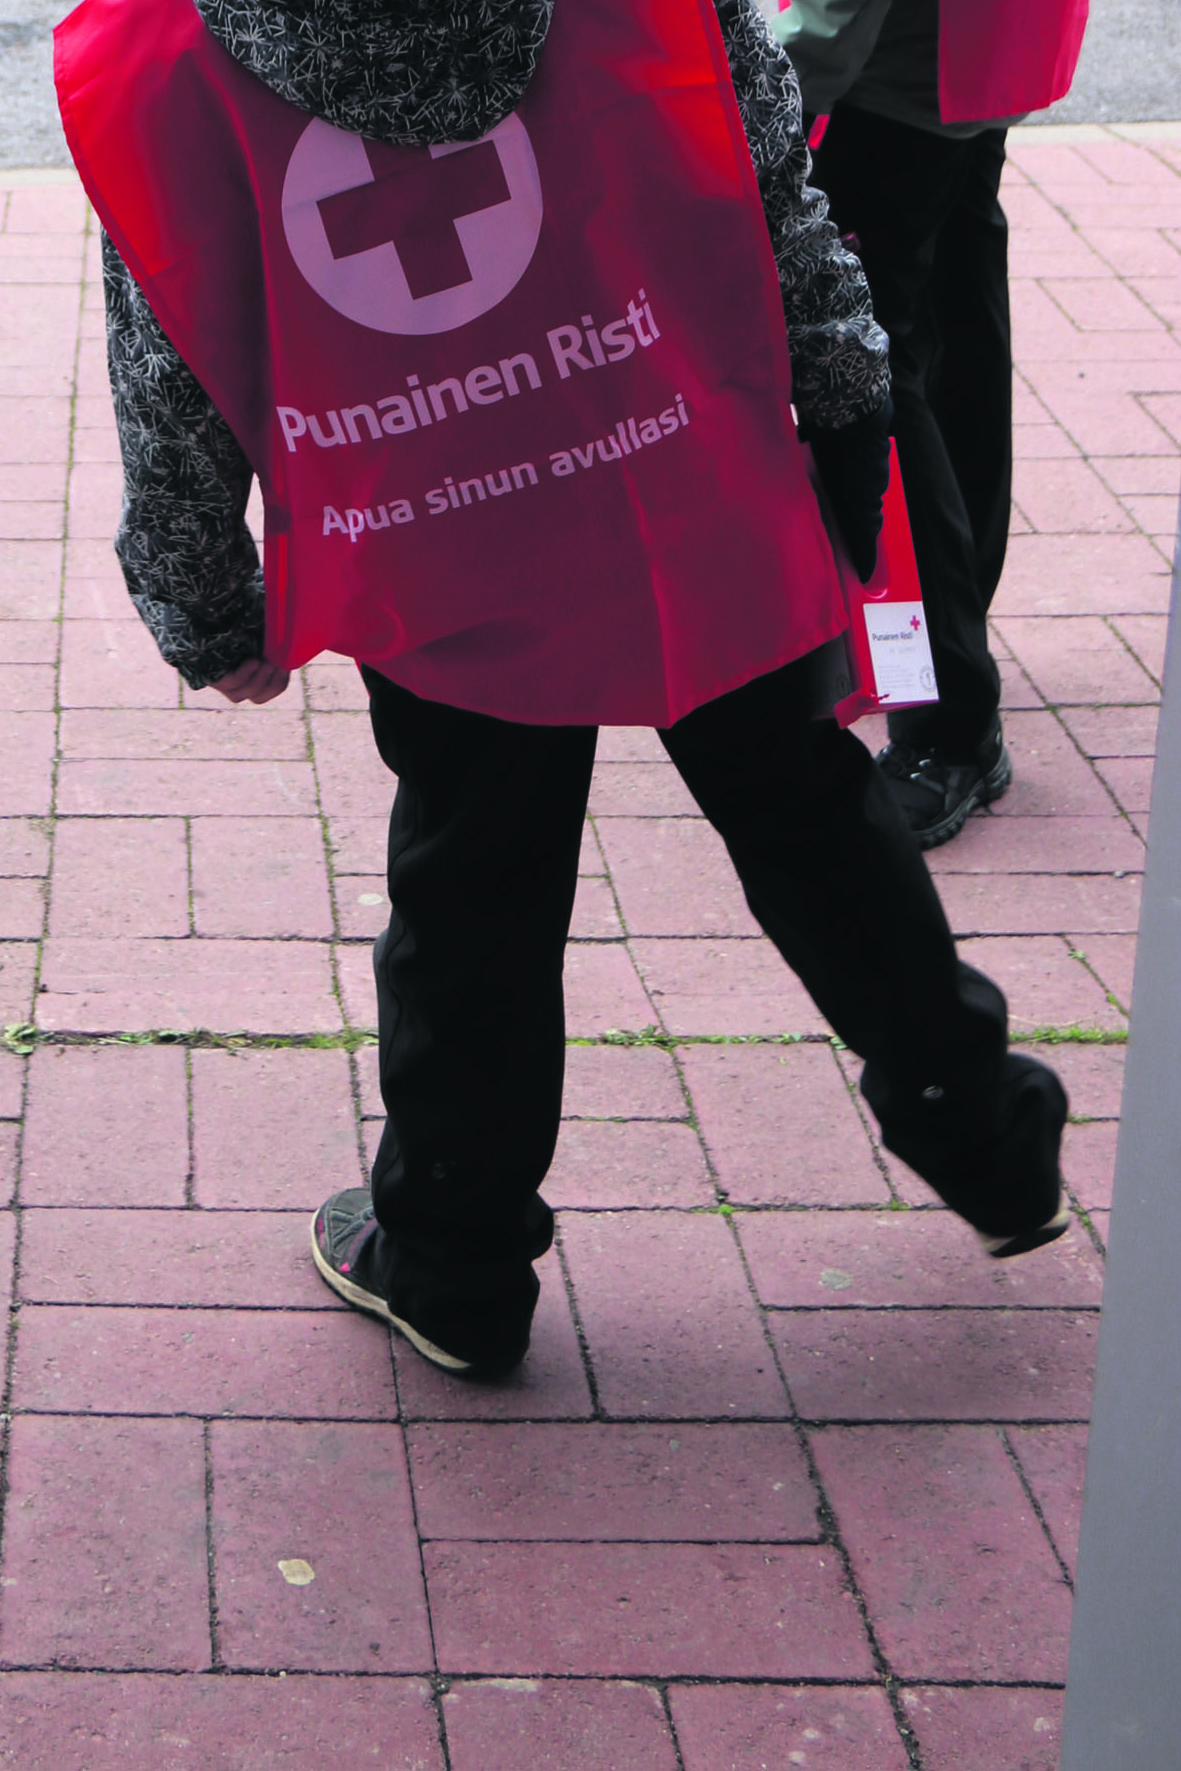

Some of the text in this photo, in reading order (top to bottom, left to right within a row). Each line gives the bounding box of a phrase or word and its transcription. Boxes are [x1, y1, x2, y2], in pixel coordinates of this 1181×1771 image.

[276, 288, 661, 452] Punainen Risti
[323, 394, 690, 542] Apua sinun avullasi
